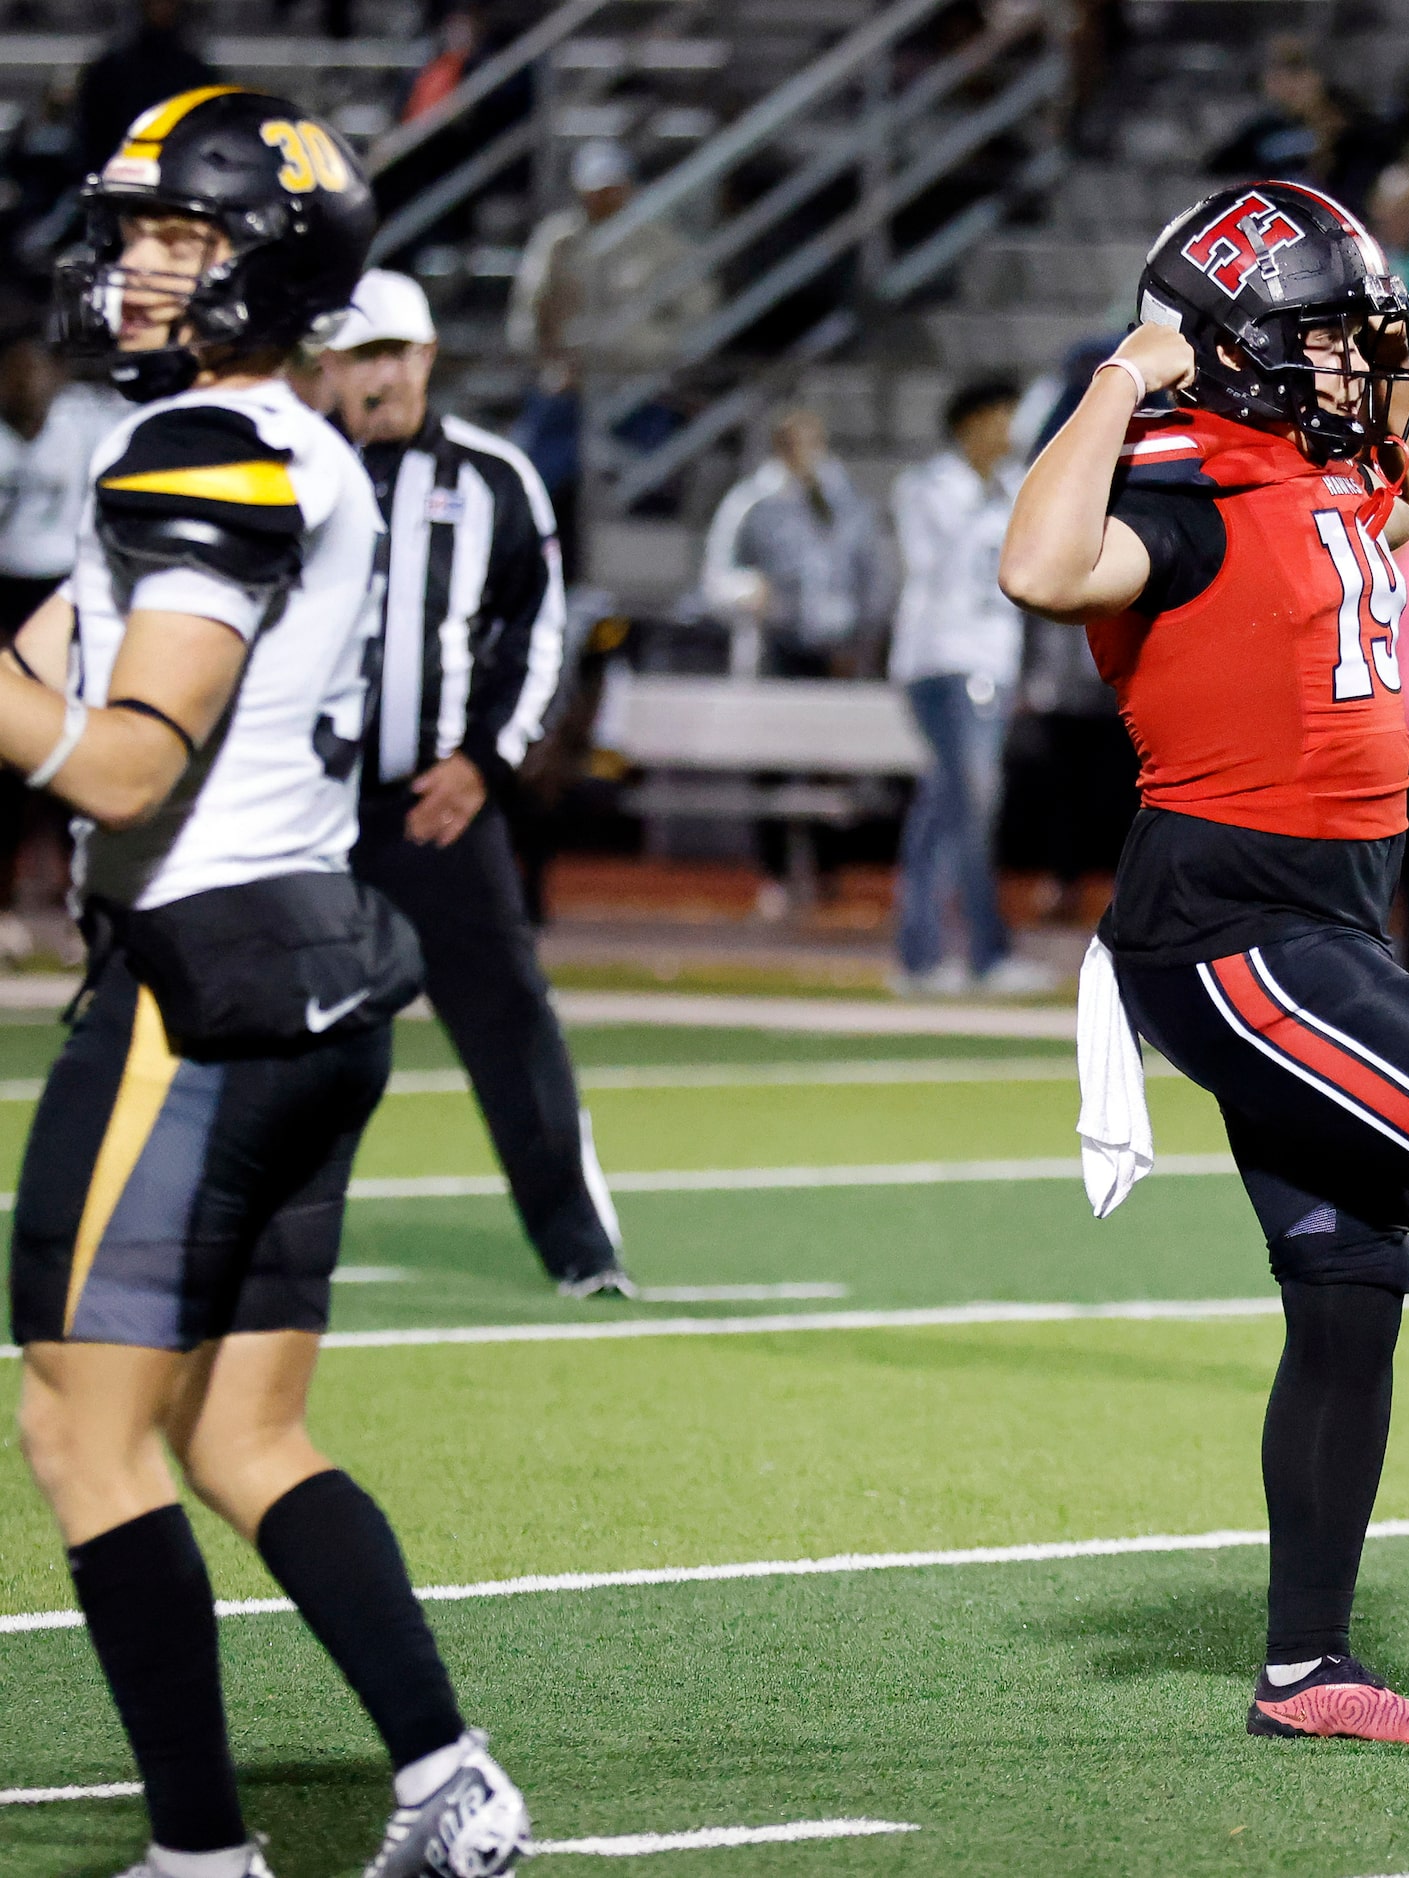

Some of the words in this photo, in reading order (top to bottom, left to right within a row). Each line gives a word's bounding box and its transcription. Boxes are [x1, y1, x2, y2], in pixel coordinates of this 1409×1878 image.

[259, 117, 350, 194] 30
[1181, 191, 1305, 300] H
[1311, 507, 1408, 704] 19
